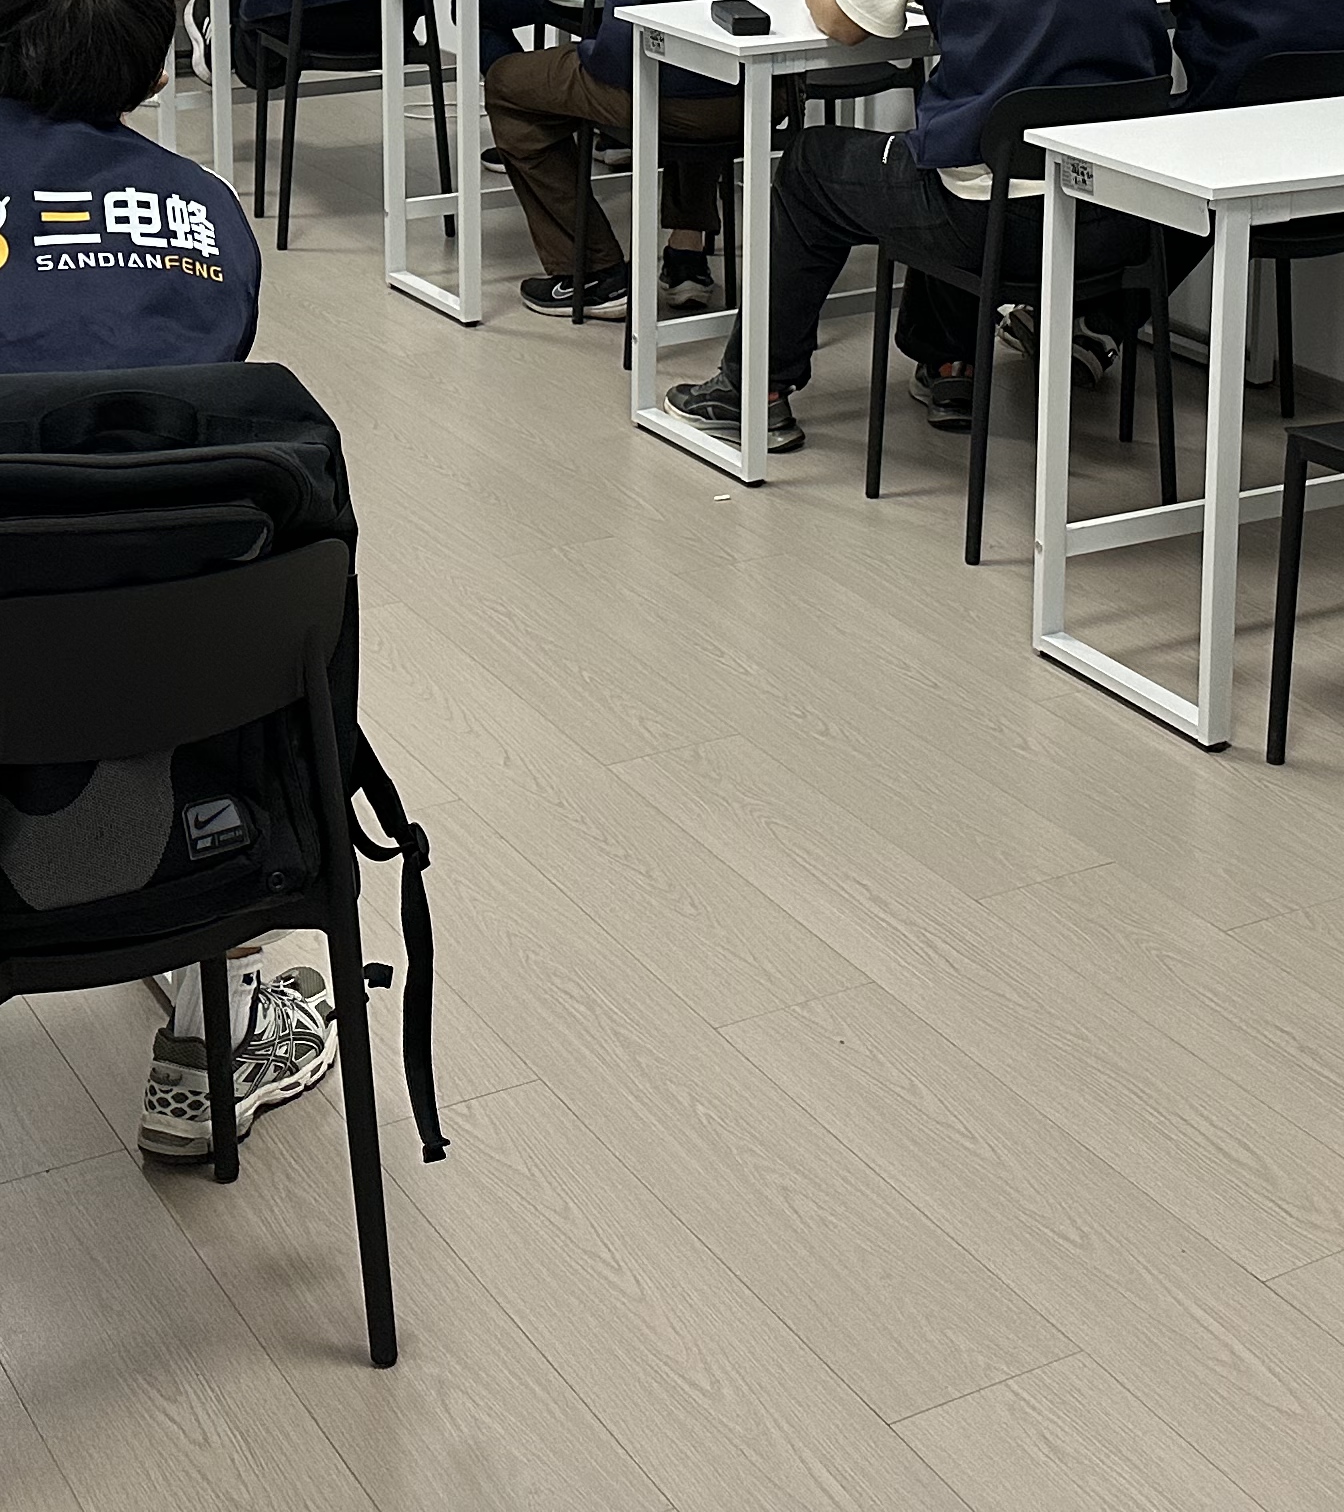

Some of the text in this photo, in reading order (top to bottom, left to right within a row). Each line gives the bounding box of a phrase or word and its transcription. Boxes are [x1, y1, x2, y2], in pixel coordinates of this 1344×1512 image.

[33, 187, 219, 258] 三电蜂
[36, 252, 224, 282] SANDIANFENG
